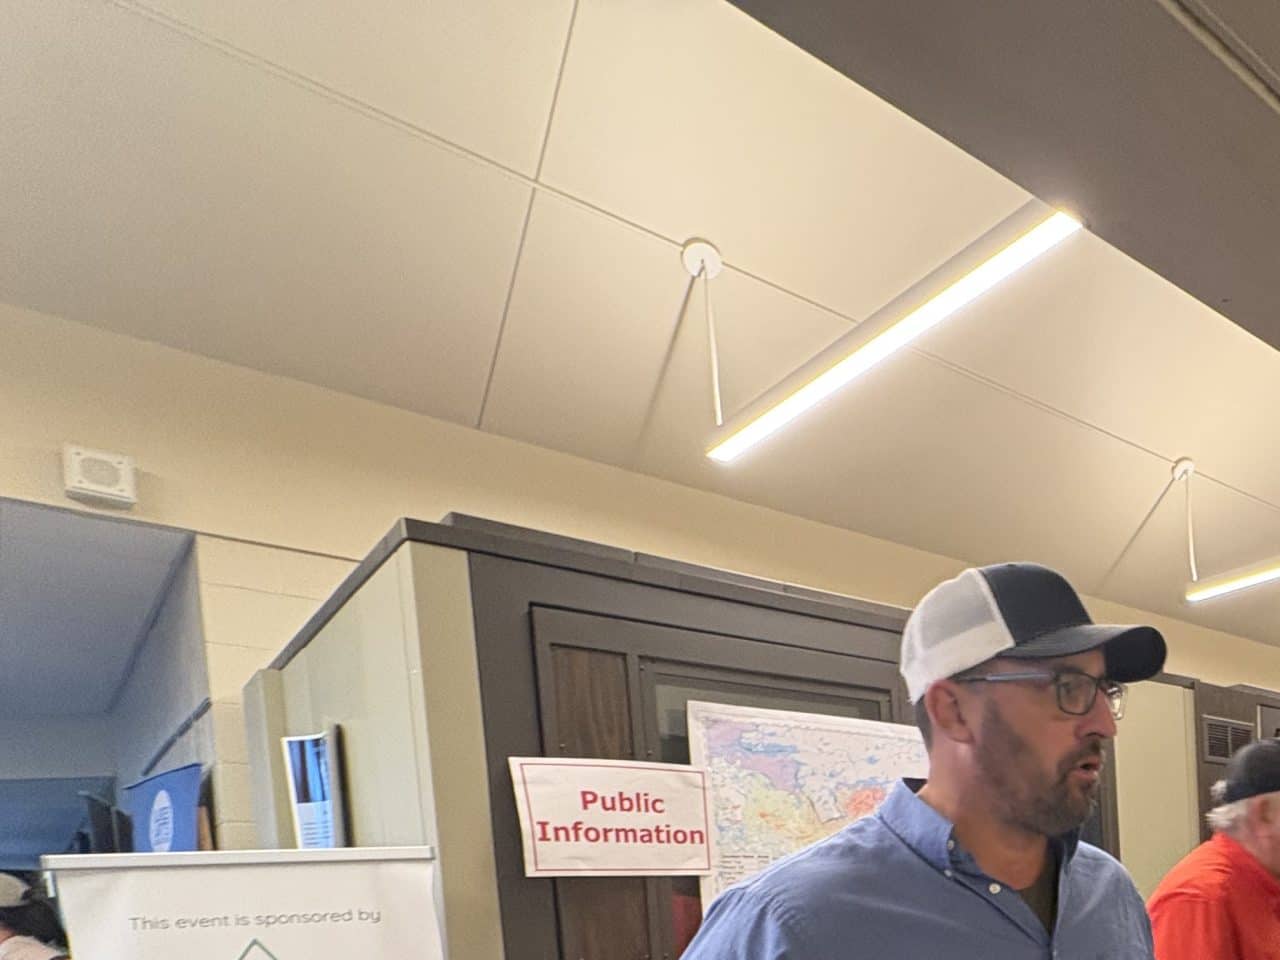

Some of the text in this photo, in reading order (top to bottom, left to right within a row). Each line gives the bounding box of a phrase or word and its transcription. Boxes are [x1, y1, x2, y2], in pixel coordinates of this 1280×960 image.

[537, 789, 705, 845] Public Information
[128, 908, 382, 931] This event is sponsored by
